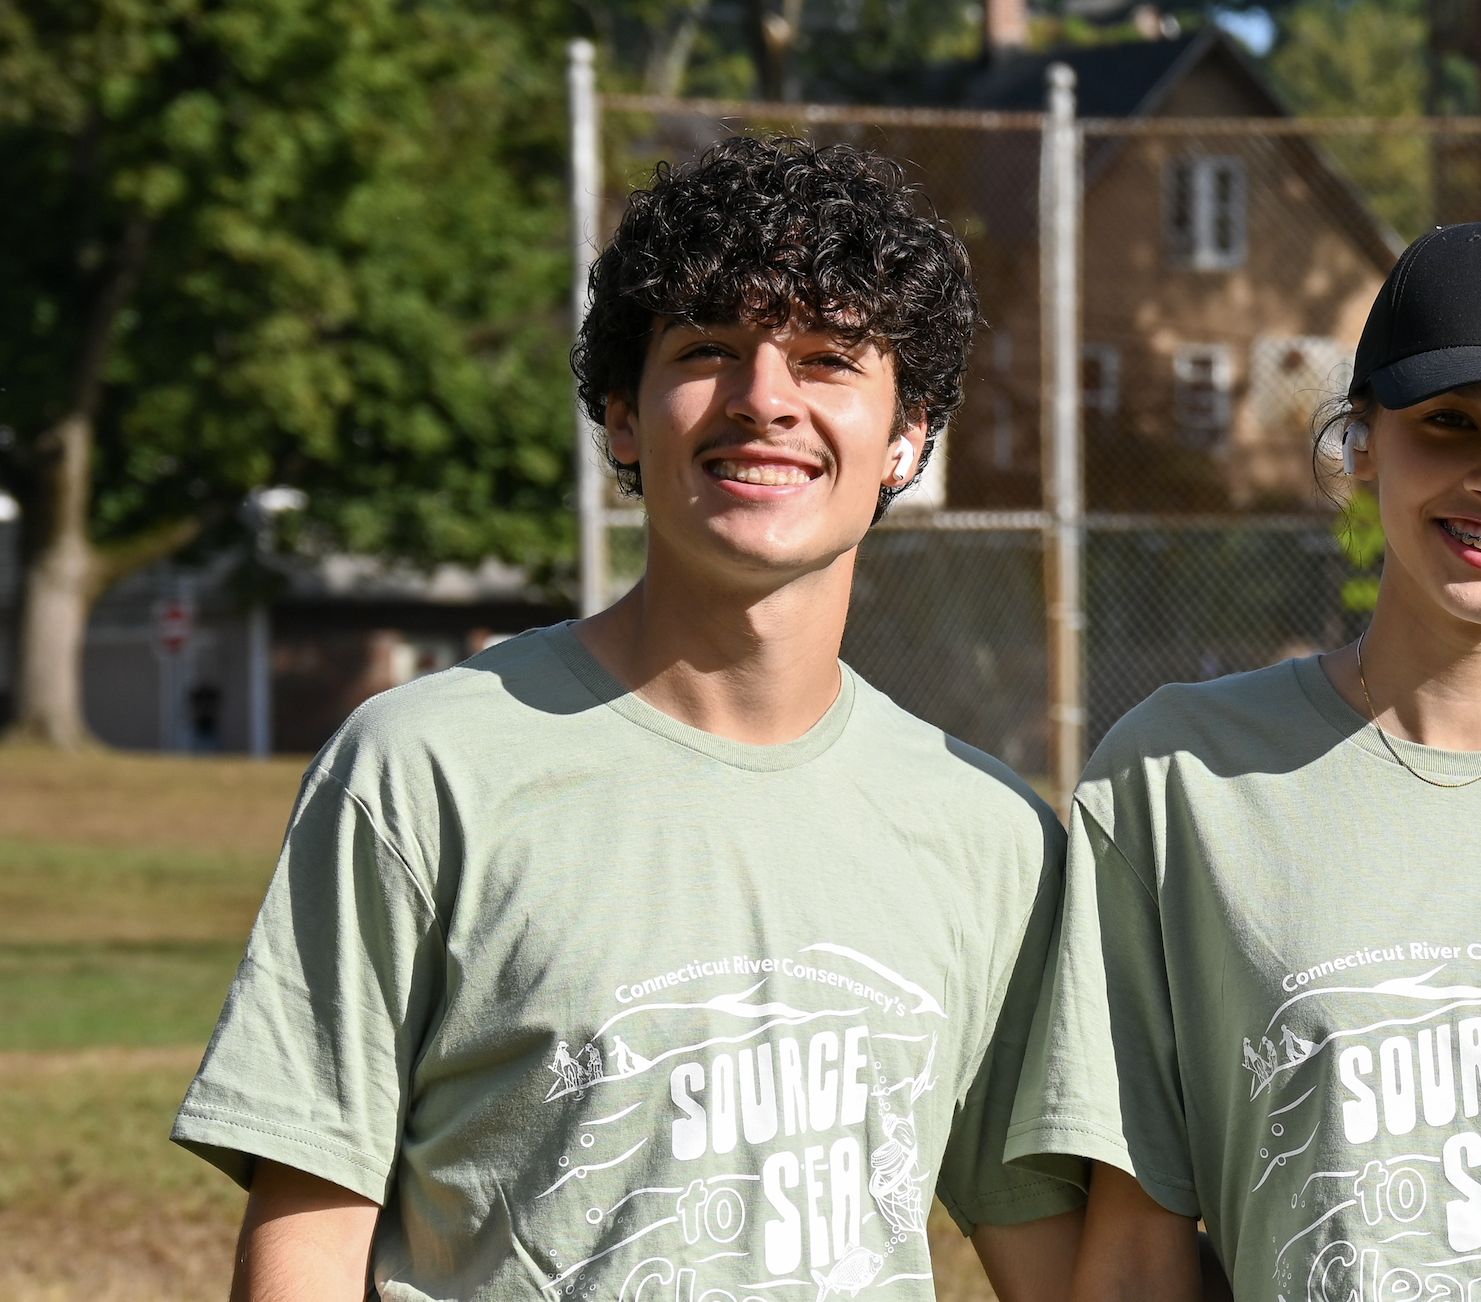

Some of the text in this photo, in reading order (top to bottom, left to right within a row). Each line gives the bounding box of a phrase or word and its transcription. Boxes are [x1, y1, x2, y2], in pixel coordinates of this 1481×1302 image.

[614, 954, 906, 1018] Connecticut River Conservancy's
[1281, 944, 1406, 993] Connecticut
[1409, 941, 1461, 960] River
[671, 1024, 869, 1162] SOURCE
[677, 1136, 861, 1276] to SEA
[1353, 1160, 1427, 1226] to
